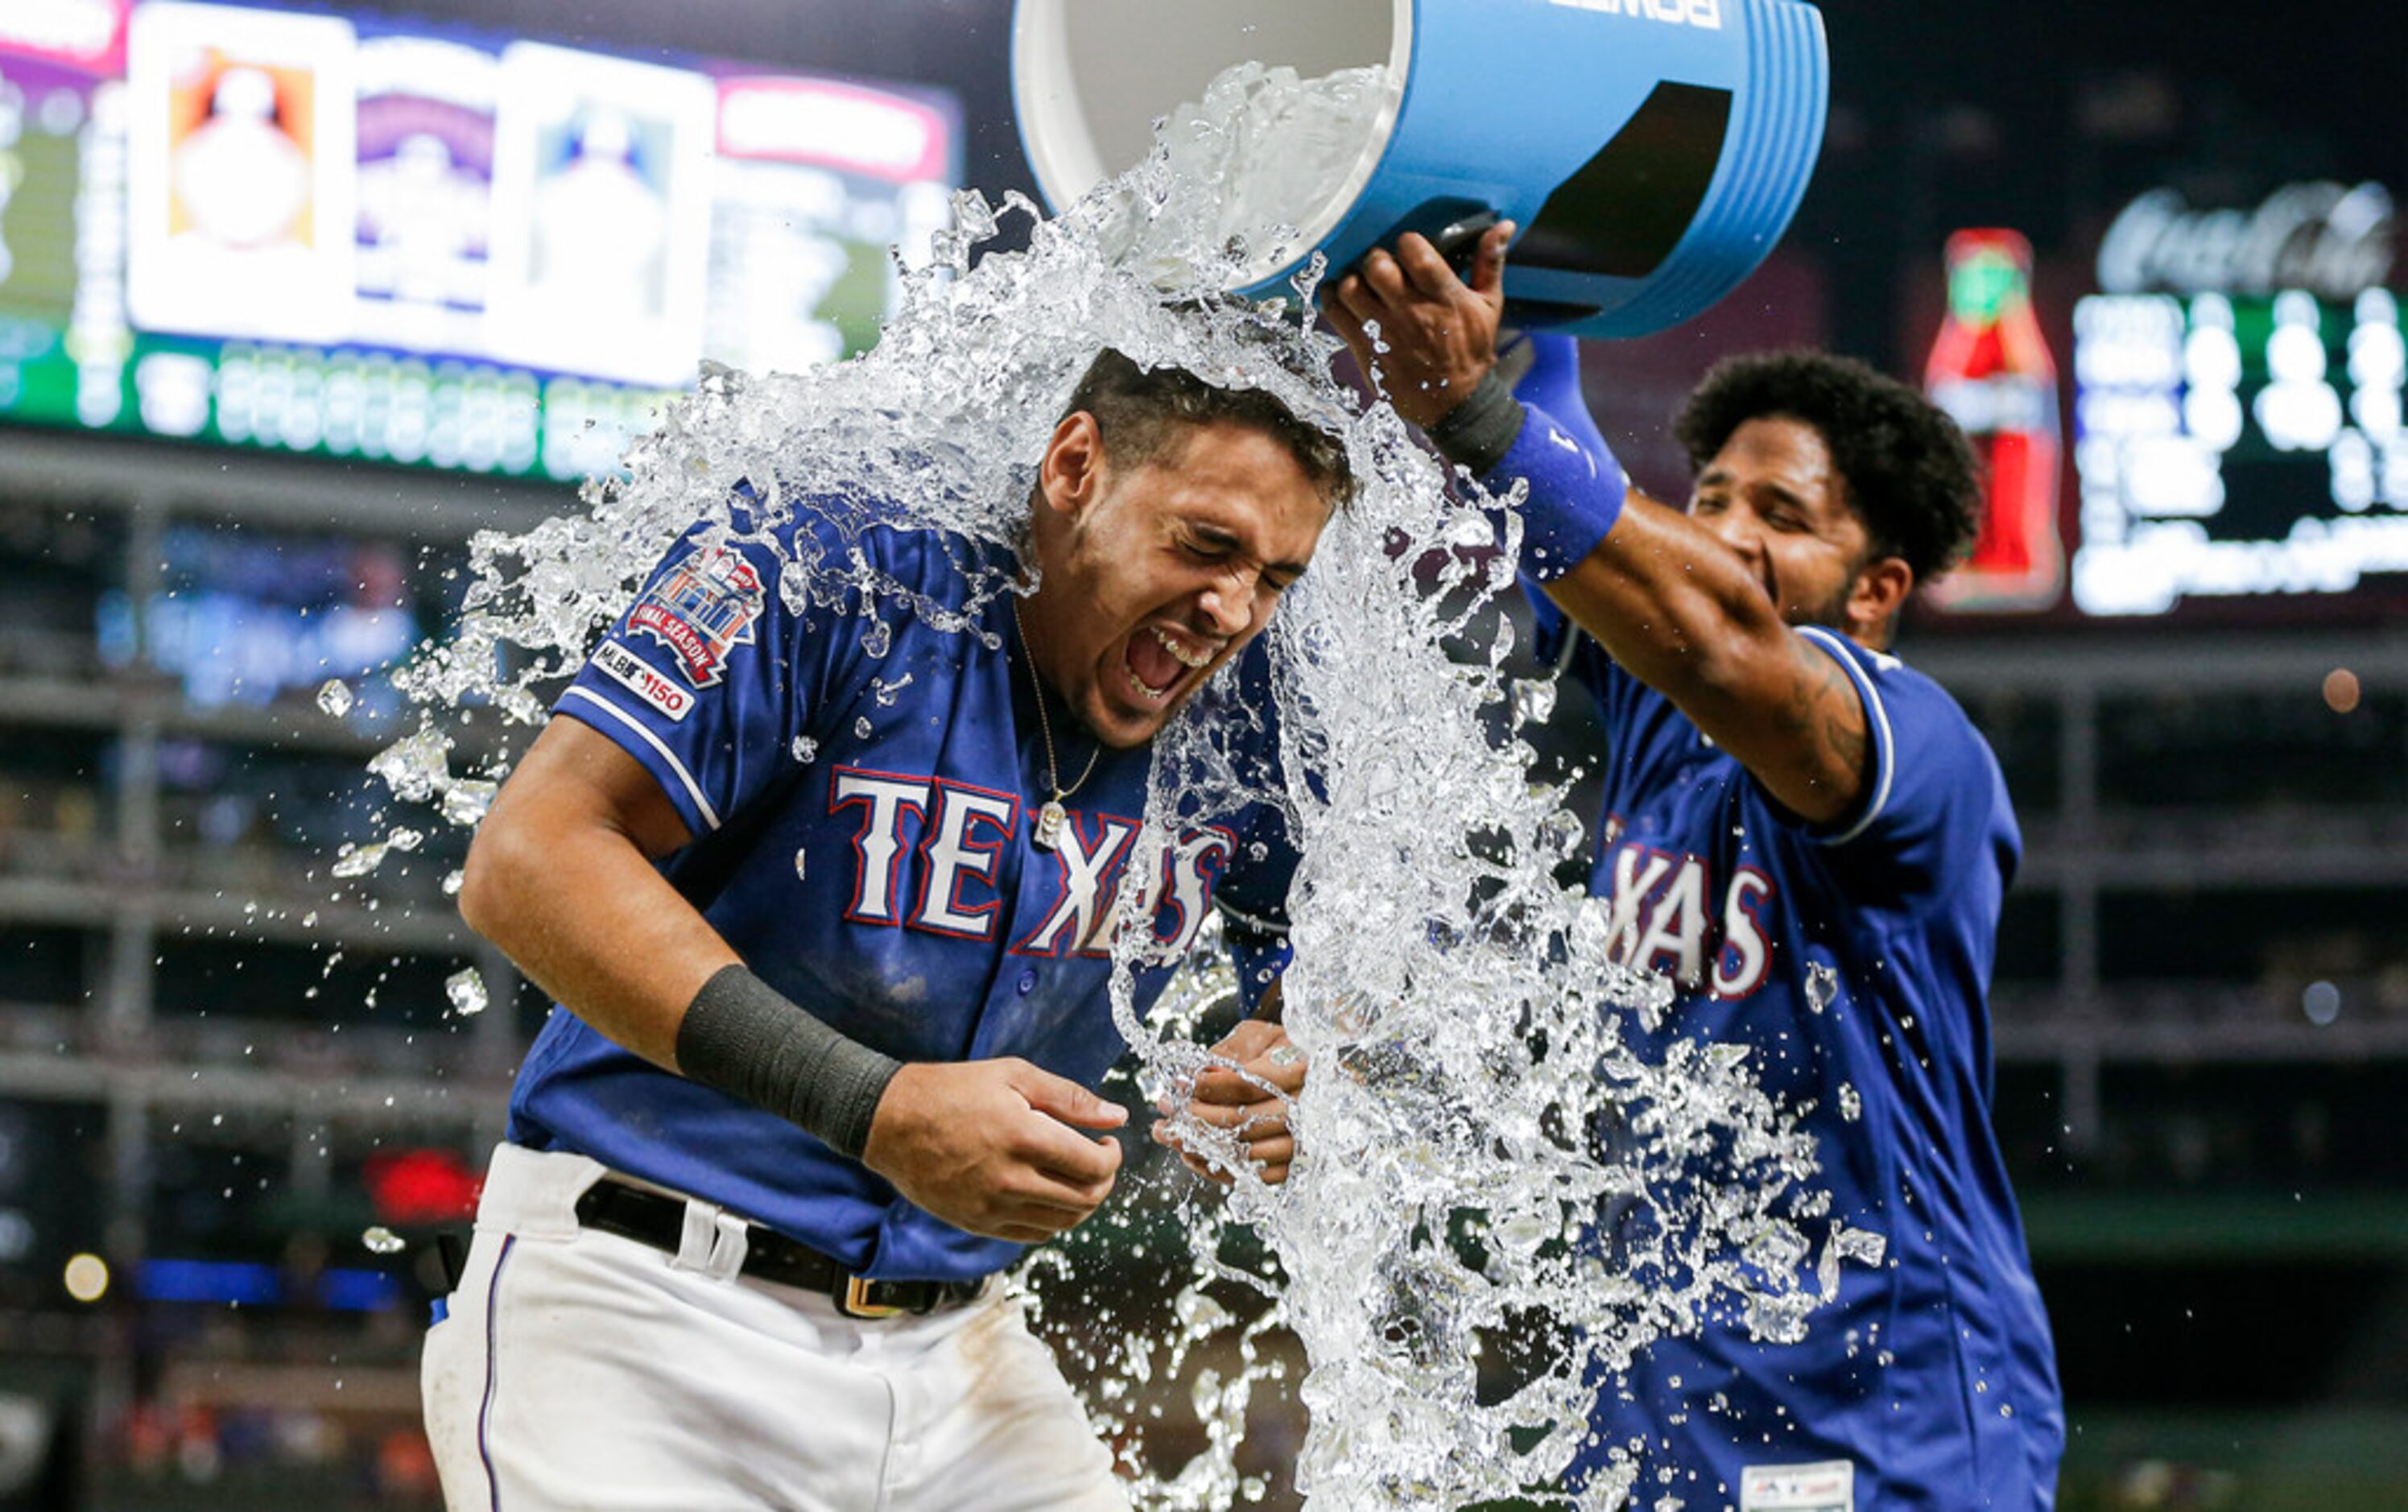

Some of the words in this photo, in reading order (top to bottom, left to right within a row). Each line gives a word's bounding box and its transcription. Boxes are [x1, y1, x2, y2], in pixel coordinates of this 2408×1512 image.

[664, 618, 709, 667] SEASON
[597, 647, 628, 673] MLB
[648, 680, 683, 711] 150
[1606, 813, 1776, 1001] XAS
